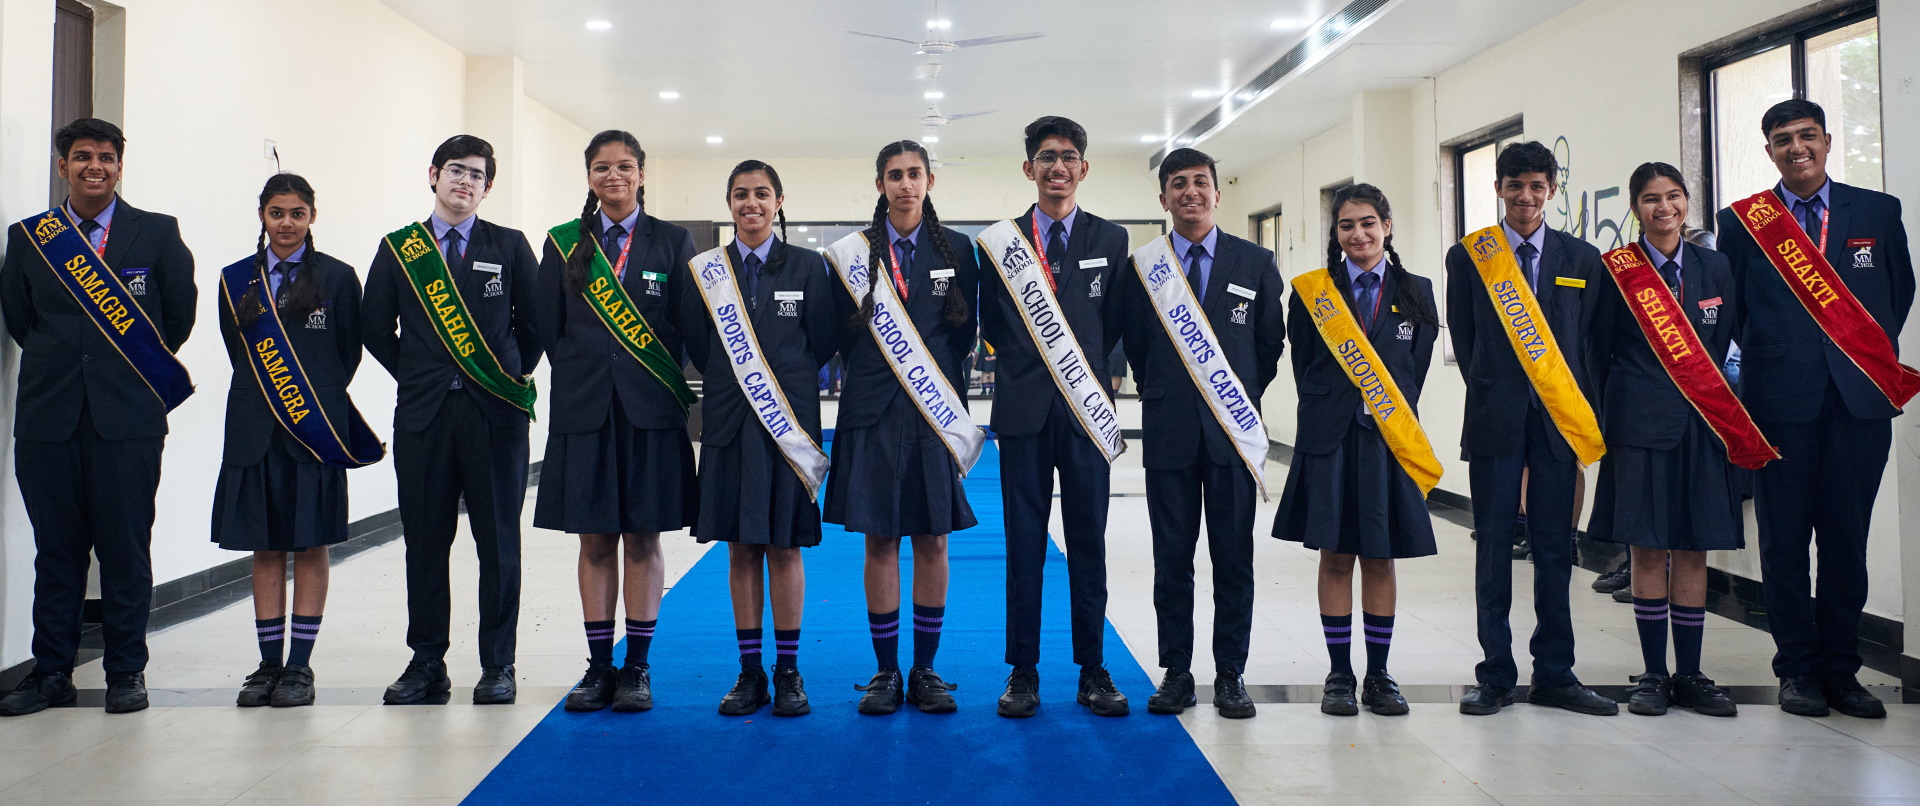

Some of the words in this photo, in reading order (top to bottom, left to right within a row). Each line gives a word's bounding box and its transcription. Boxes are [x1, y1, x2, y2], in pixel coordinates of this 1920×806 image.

[1749, 206, 1777, 225] MM
[1753, 211, 1783, 232] SCHOOL
[37, 219, 64, 240] MM
[40, 225, 70, 246] SCHOOL
[401, 241, 428, 258] MM
[404, 246, 433, 263] SCHOOL
[1473, 240, 1499, 257] MM
[1477, 246, 1504, 263] SCHOOL
[1854, 253, 1873, 263] MM
[1004, 250, 1030, 273] MM
[1610, 252, 1638, 267] MM
[1615, 259, 1646, 275] SCHOOL
[702, 266, 727, 284] MM
[1007, 258, 1036, 281] SCHOOL
[1149, 266, 1172, 285] MM
[1777, 239, 1839, 309] SHAKTI
[128, 282, 147, 291] MM
[485, 282, 503, 292] MM
[648, 280, 661, 291] MM
[705, 275, 732, 292] SCHOOL
[933, 282, 950, 291] MM
[1090, 283, 1102, 293] MM
[1152, 272, 1178, 294] SCHOOL
[64, 254, 135, 336] SAMAGRA
[483, 290, 504, 298] SCHOOL
[589, 276, 653, 349] SAAHAS
[780, 303, 797, 313] MM
[1232, 310, 1248, 319] MM
[1313, 300, 1336, 320] MM
[1703, 307, 1718, 318] MM
[304, 322, 327, 330] SCHOOL
[308, 314, 327, 325] MM
[425, 279, 476, 358] SAAHAS
[1317, 309, 1341, 328] SCHOOL
[1493, 280, 1547, 363] SHOURYA
[1636, 287, 1691, 362] SHAKTI
[1398, 326, 1414, 335] MM
[717, 303, 753, 365] SPORTS
[744, 372, 792, 439] CAPTAIN
[872, 302, 914, 364] SCHOOL
[907, 365, 958, 429] CAPTAIN
[1020, 280, 1065, 350] SCHOOL
[1056, 350, 1088, 390] VICE
[1083, 391, 1121, 452] CAPTAIN
[1169, 304, 1216, 365] SPORTS
[1209, 369, 1259, 433] CAPTAIN
[256, 337, 310, 425] SAMAGRA
[1337, 339, 1396, 422] SHOURYA
